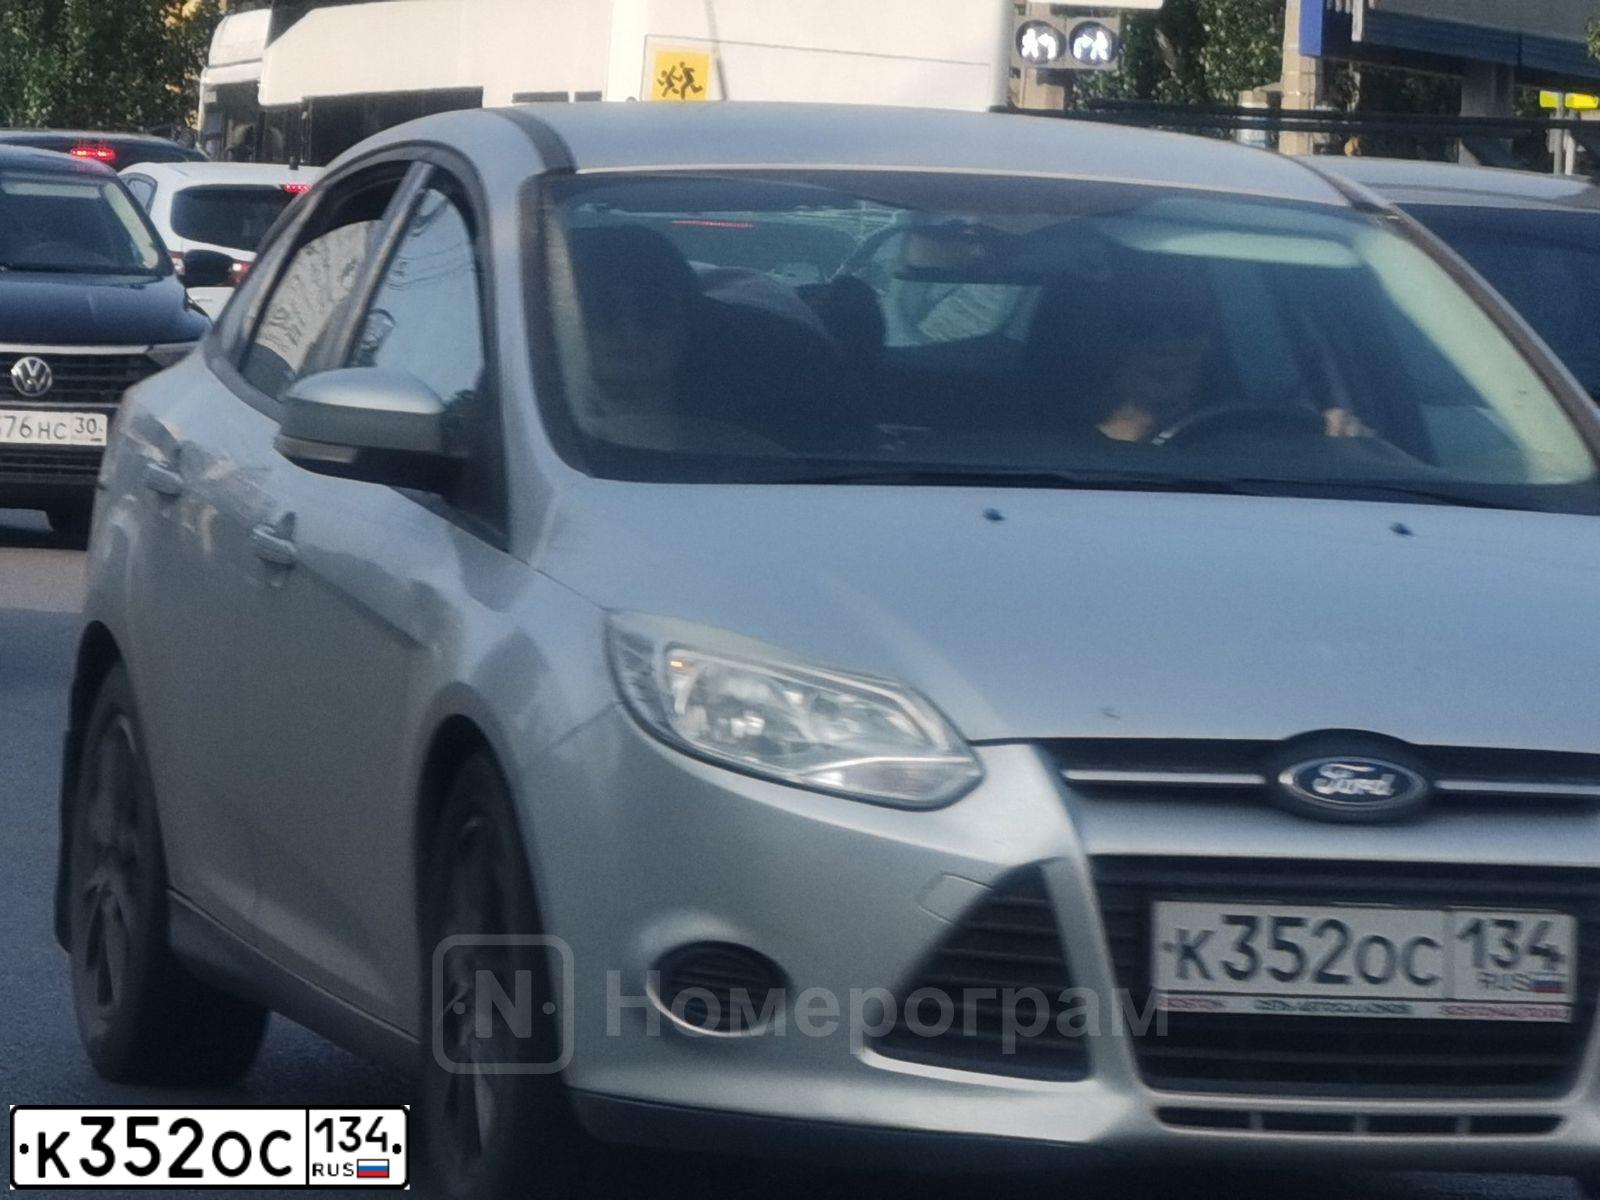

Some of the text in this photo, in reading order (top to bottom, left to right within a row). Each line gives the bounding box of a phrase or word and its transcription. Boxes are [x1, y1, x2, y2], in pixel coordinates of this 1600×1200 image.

[0, 415, 97, 439] 76НС 30
[1312, 763, 1396, 796] Ford
[1173, 914, 1567, 987] К352ОС 134
